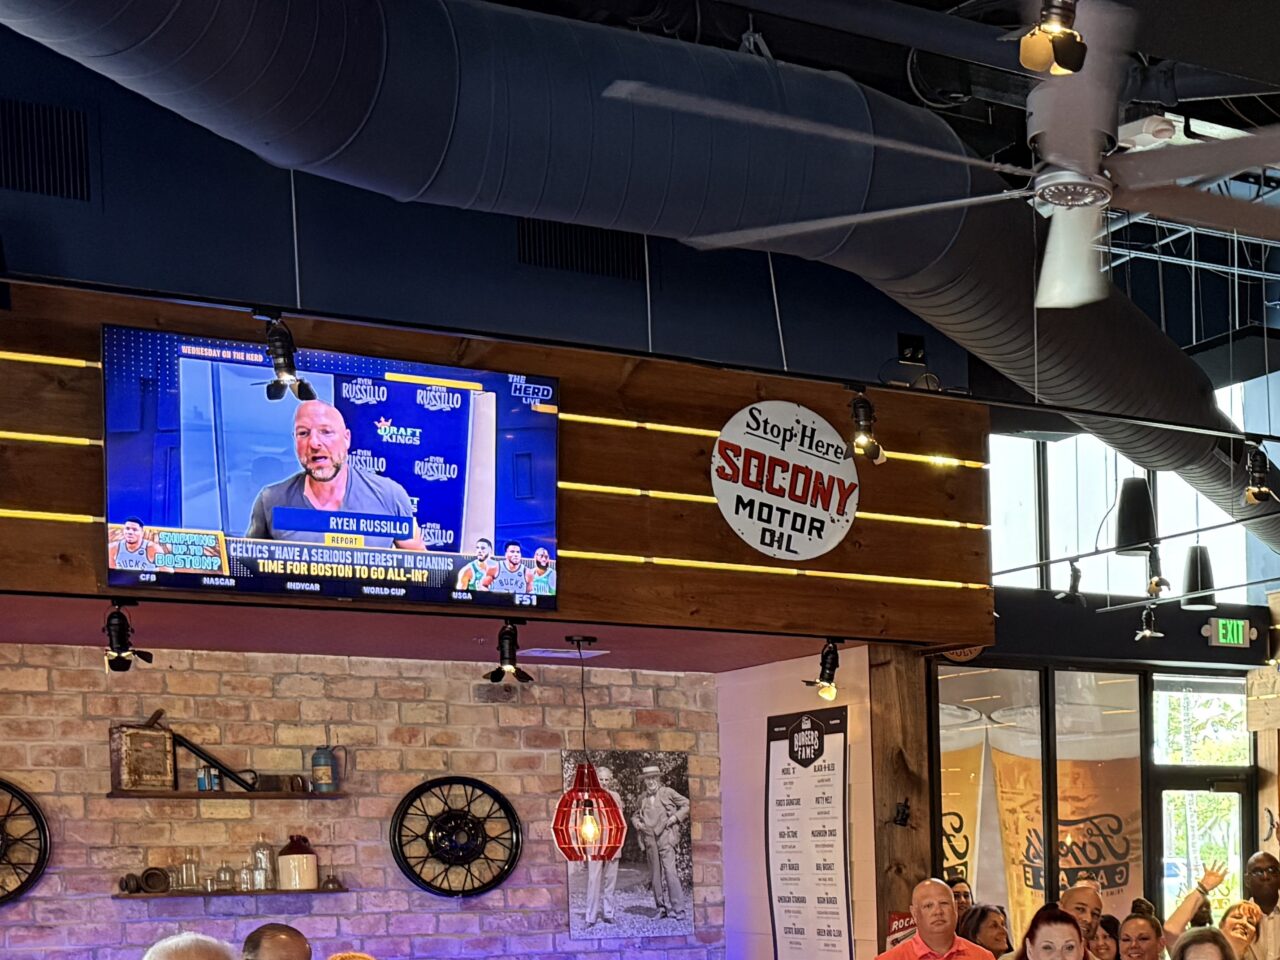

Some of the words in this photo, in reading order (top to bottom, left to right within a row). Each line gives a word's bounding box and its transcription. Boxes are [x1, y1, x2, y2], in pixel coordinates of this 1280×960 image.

[181, 345, 221, 358] WEDNESDAY
[508, 374, 526, 384] THE
[342, 382, 388, 402] RUSSILLO
[416, 389, 461, 408] RUSSILLO
[511, 383, 553, 400] HERD
[378, 426, 422, 437] DRAFT
[382, 435, 421, 445] KINGS
[746, 407, 794, 451] Stop
[799, 425, 844, 460] Here
[348, 455, 386, 472] USSILLO
[414, 460, 458, 478] RUSSILLO
[715, 439, 859, 516] SOCONY
[735, 494, 825, 539] MOTOR
[329, 516, 356, 530] RYEN
[360, 519, 409, 535] RUSSILLO
[159, 532, 216, 546] SHIPPING
[331, 536, 358, 545] REPORT
[421, 527, 454, 543] SSILLO
[760, 527, 800, 555] OIL
[155, 554, 221, 570] BOSTON?
[230, 543, 268, 558] CELTICS
[302, 548, 309, 561] A
[311, 549, 351, 564] SERIOUS
[404, 556, 413, 568] IN
[416, 556, 453, 571] GIANNIS
[257, 559, 284, 574] TIME
[287, 561, 308, 575] FOR
[310, 562, 352, 578] BOSTON
[355, 565, 370, 578] TO
[372, 566, 385, 580] GO
[386, 567, 428, 582] ALL-IN?
[139, 573, 157, 581] CFB
[203, 577, 236, 586] NASCAR
[287, 582, 320, 591] INDYCAR
[362, 586, 389, 595] WORLD
[391, 588, 406, 596] CUP
[451, 591, 473, 600] USGA
[514, 594, 537, 605] FS1
[1219, 619, 1244, 645] EXIT
[798, 746, 815, 760] FAME
